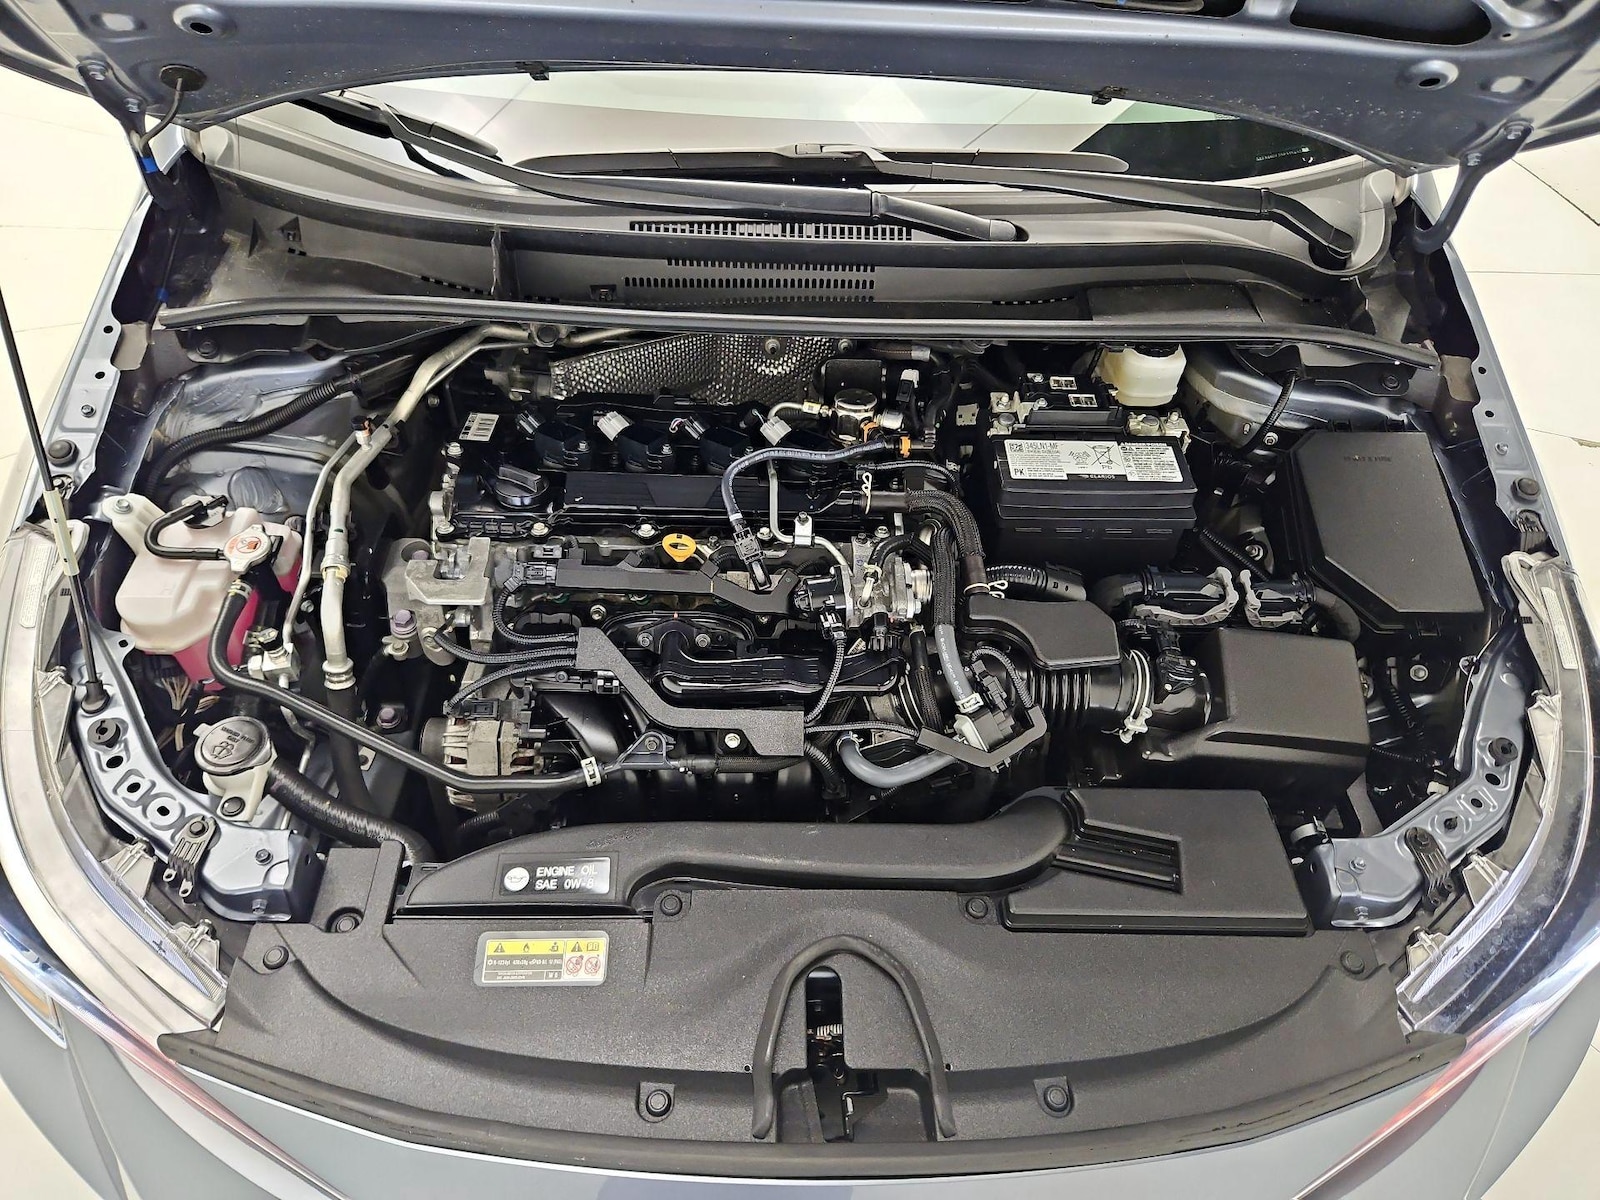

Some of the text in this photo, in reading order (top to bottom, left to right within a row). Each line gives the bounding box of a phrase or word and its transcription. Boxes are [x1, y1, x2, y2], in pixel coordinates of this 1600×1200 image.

[1013, 468, 1025, 476] PK
[536, 864, 598, 877] ENGINE OIL
[535, 878, 594, 891] SAE 0W-8
